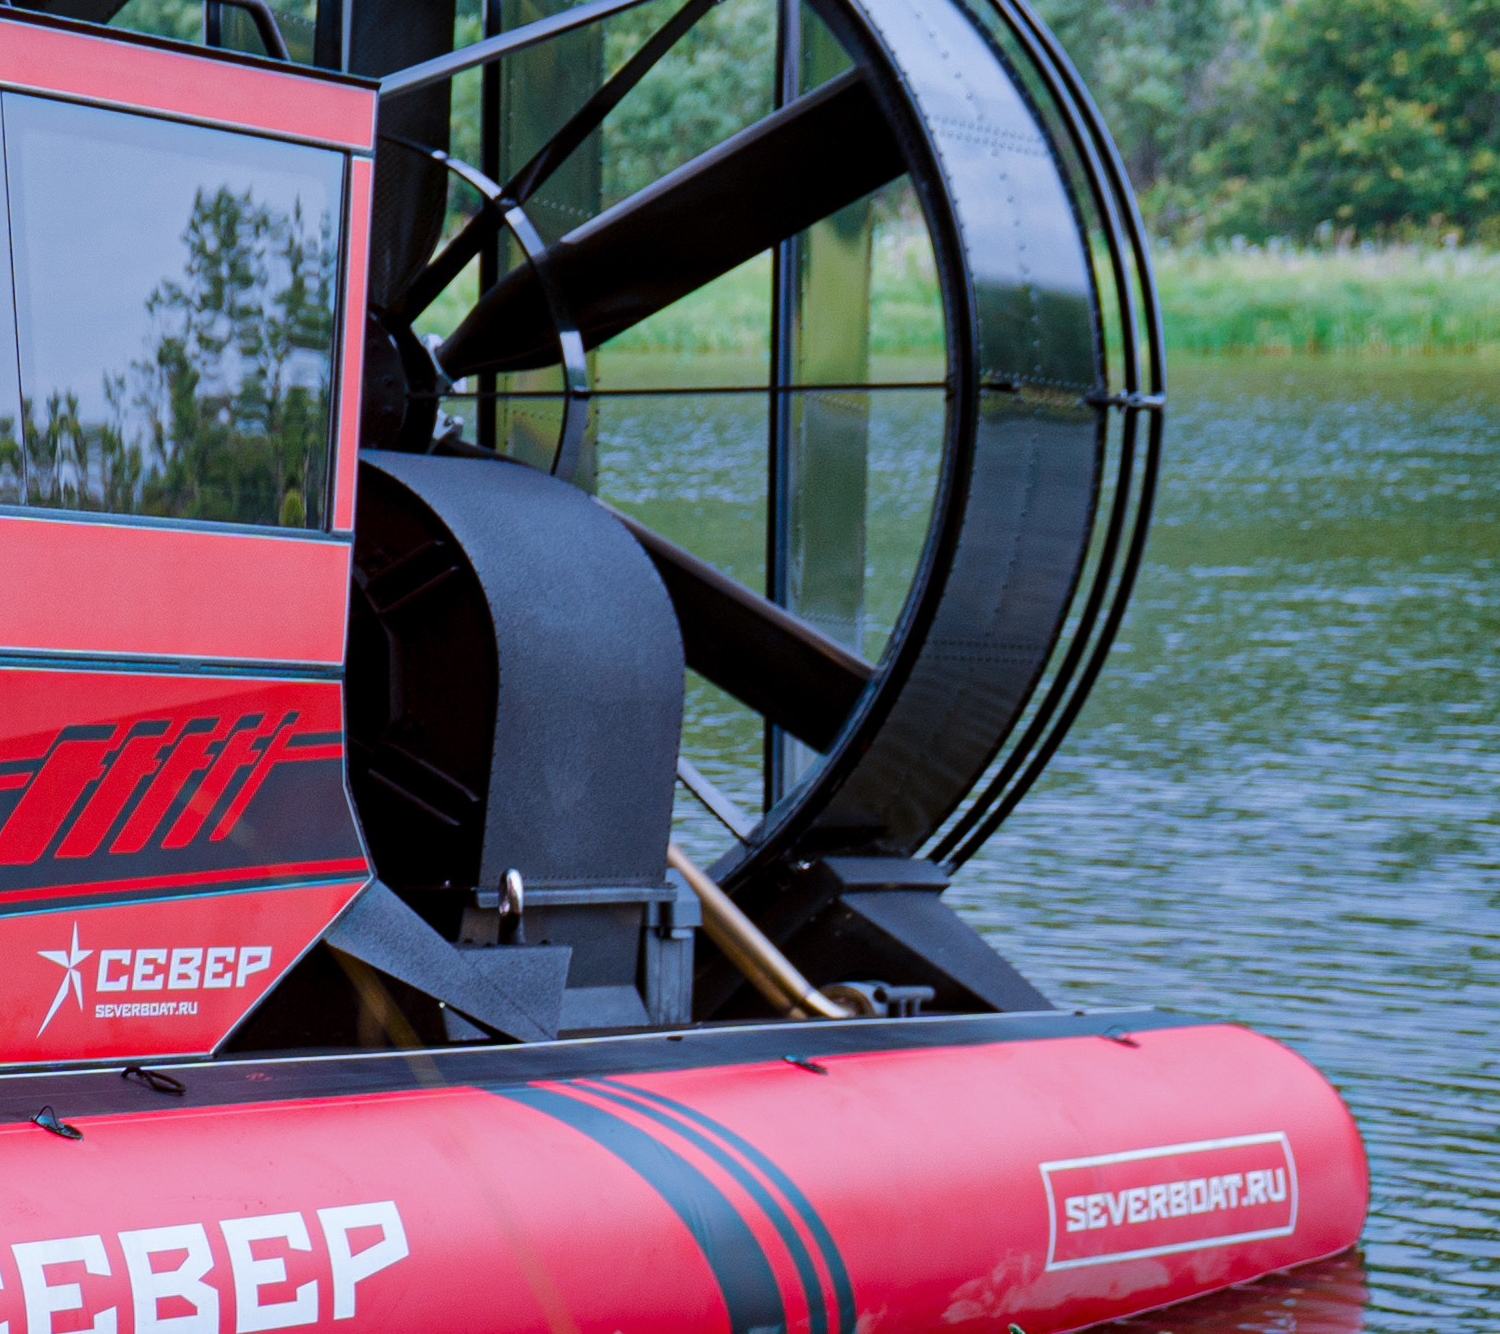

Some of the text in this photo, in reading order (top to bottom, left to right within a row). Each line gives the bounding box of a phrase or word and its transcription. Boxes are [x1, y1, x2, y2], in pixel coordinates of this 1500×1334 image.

[96, 946, 273, 992] СЕВЕР
[95, 1001, 198, 1018] SEVERBOAT.RU
[1065, 1167, 1286, 1232] SEVERBOAT.RU
